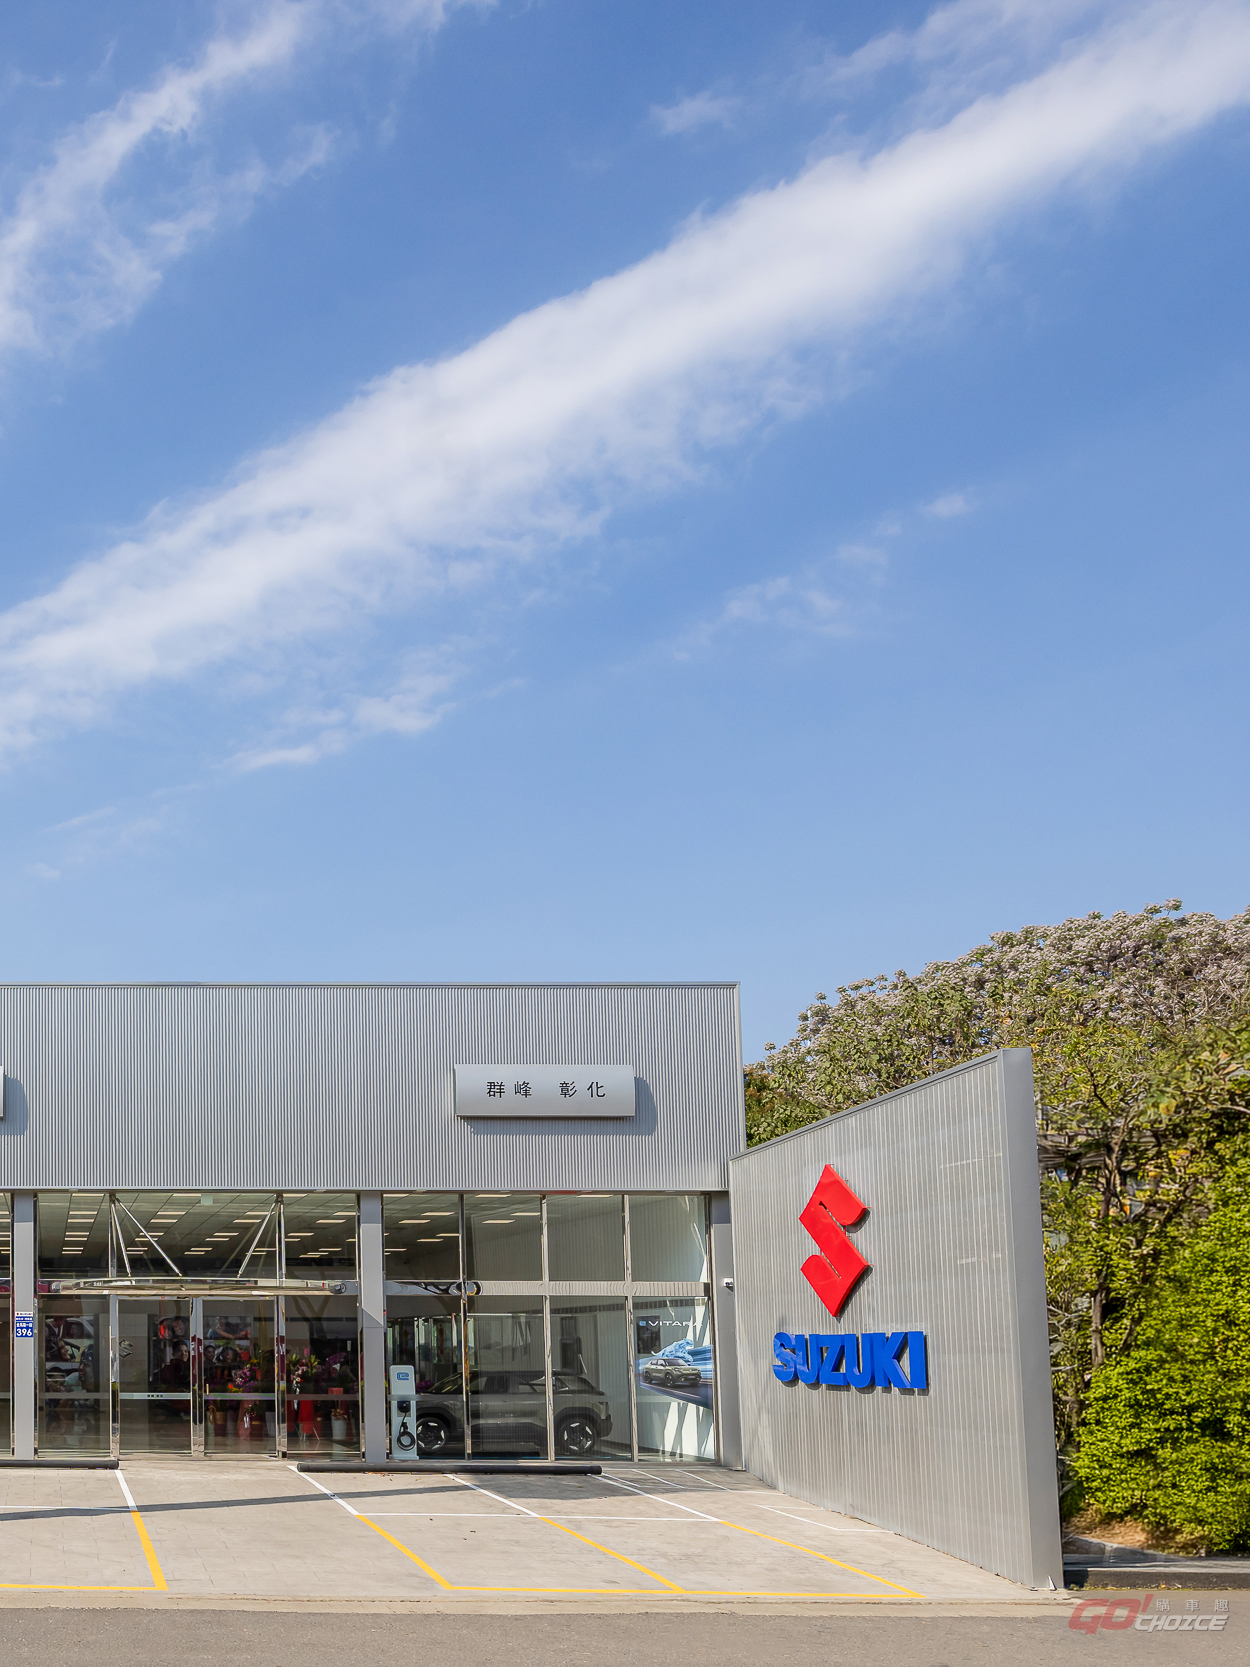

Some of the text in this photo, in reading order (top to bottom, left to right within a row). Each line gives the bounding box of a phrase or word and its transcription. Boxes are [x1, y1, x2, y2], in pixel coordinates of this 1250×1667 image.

[486, 1081, 606, 1098] 群峰 彰化
[16, 1328, 33, 1337] 396
[772, 1331, 927, 1390] SUZUKI
